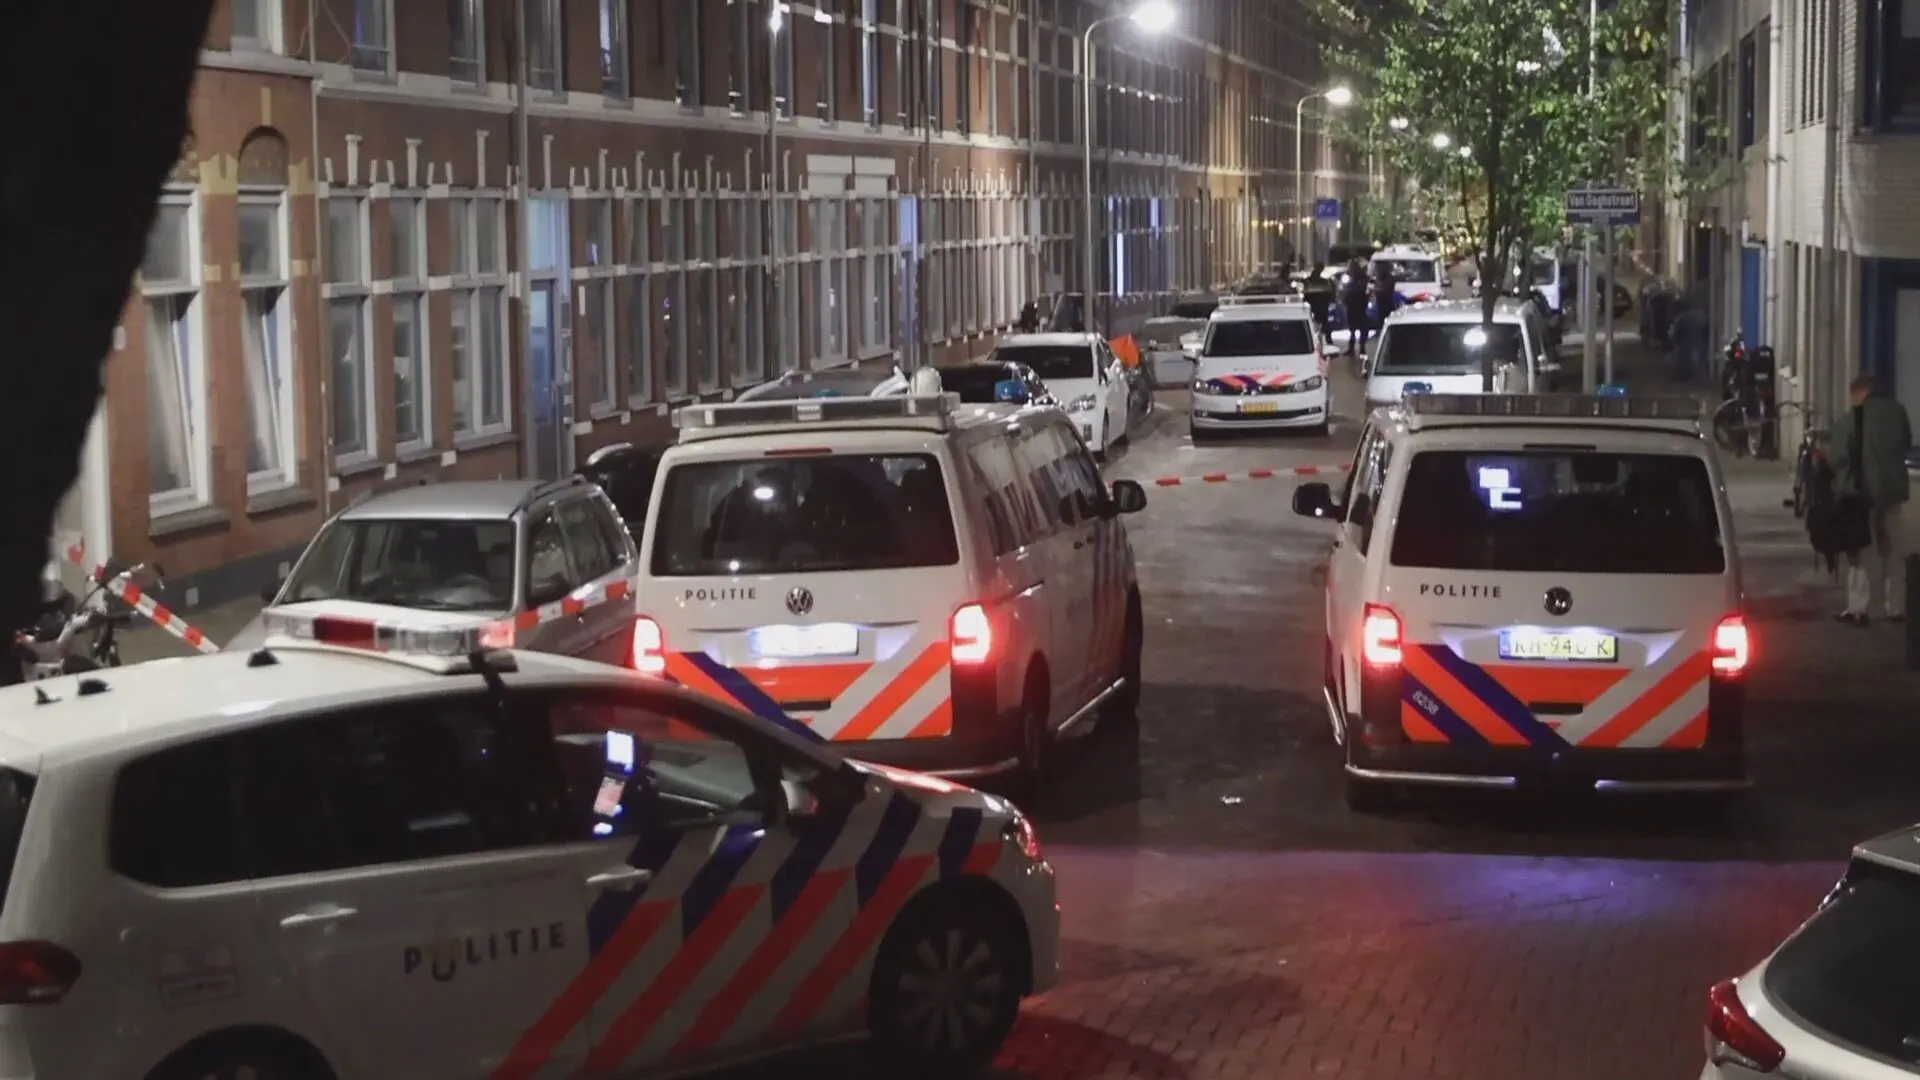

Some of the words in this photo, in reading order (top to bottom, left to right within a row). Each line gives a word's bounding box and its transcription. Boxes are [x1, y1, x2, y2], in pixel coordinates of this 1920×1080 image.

[1569, 194, 1584, 207] Van
[685, 587, 757, 601] POLITIE
[1420, 583, 1502, 598] POLITIE
